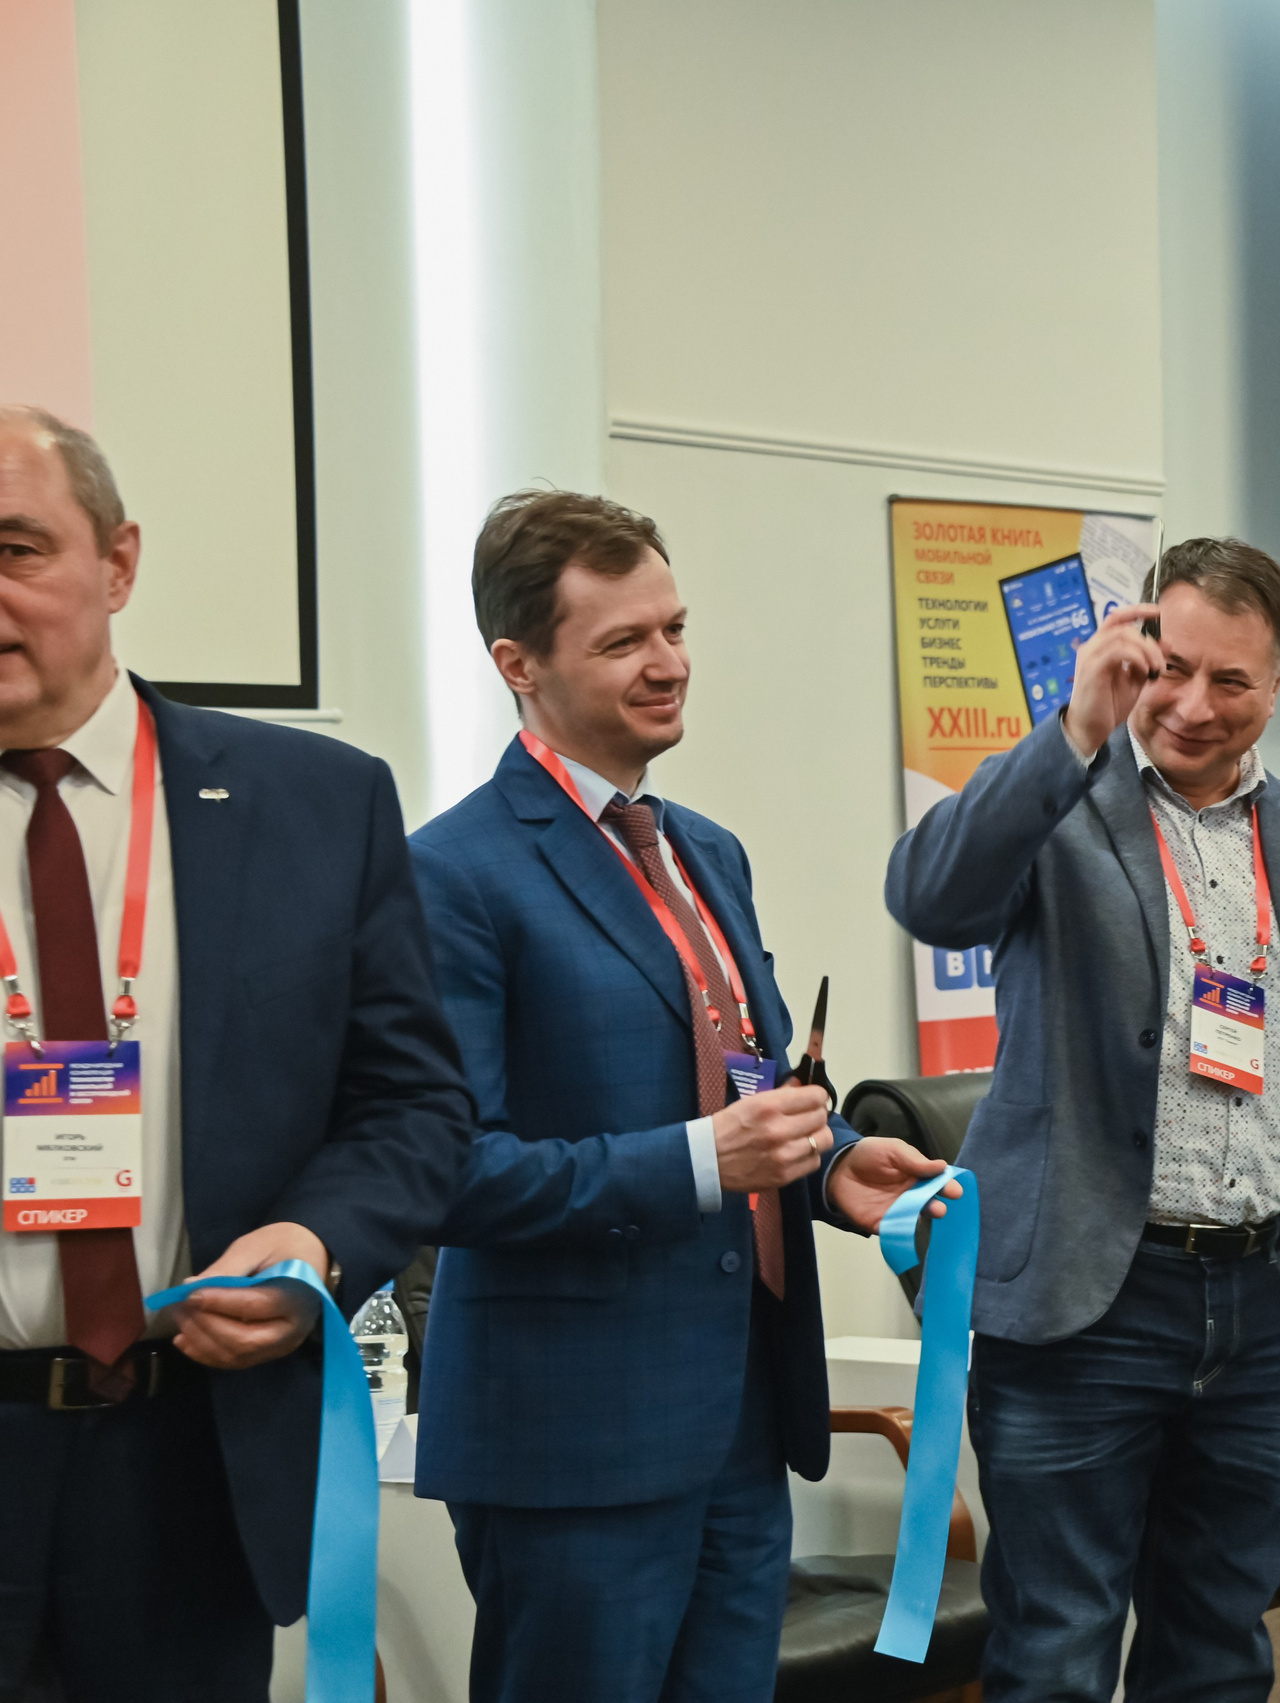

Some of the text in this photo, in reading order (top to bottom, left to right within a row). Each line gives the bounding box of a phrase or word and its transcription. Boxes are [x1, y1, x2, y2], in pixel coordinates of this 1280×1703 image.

[913, 521, 1044, 548] ЗОЛОТАЯ КНИГА
[914, 548, 992, 565] МОБИЛЬНОЙ
[916, 570, 954, 585] СВЯЗИ
[918, 598, 988, 612] ТЕХНОЛОГИИ
[919, 617, 960, 630] УСЛУГИ
[921, 636, 962, 650] БИЗНЕС
[922, 656, 966, 670] ТРЕНДЫ
[923, 676, 999, 689] ПЕРСПЕКТИВЫ
[927, 706, 1022, 738] XXIII.ru
[1197, 1061, 1236, 1081] СПИКЕР
[17, 1209, 88, 1225] СПИКЕР
